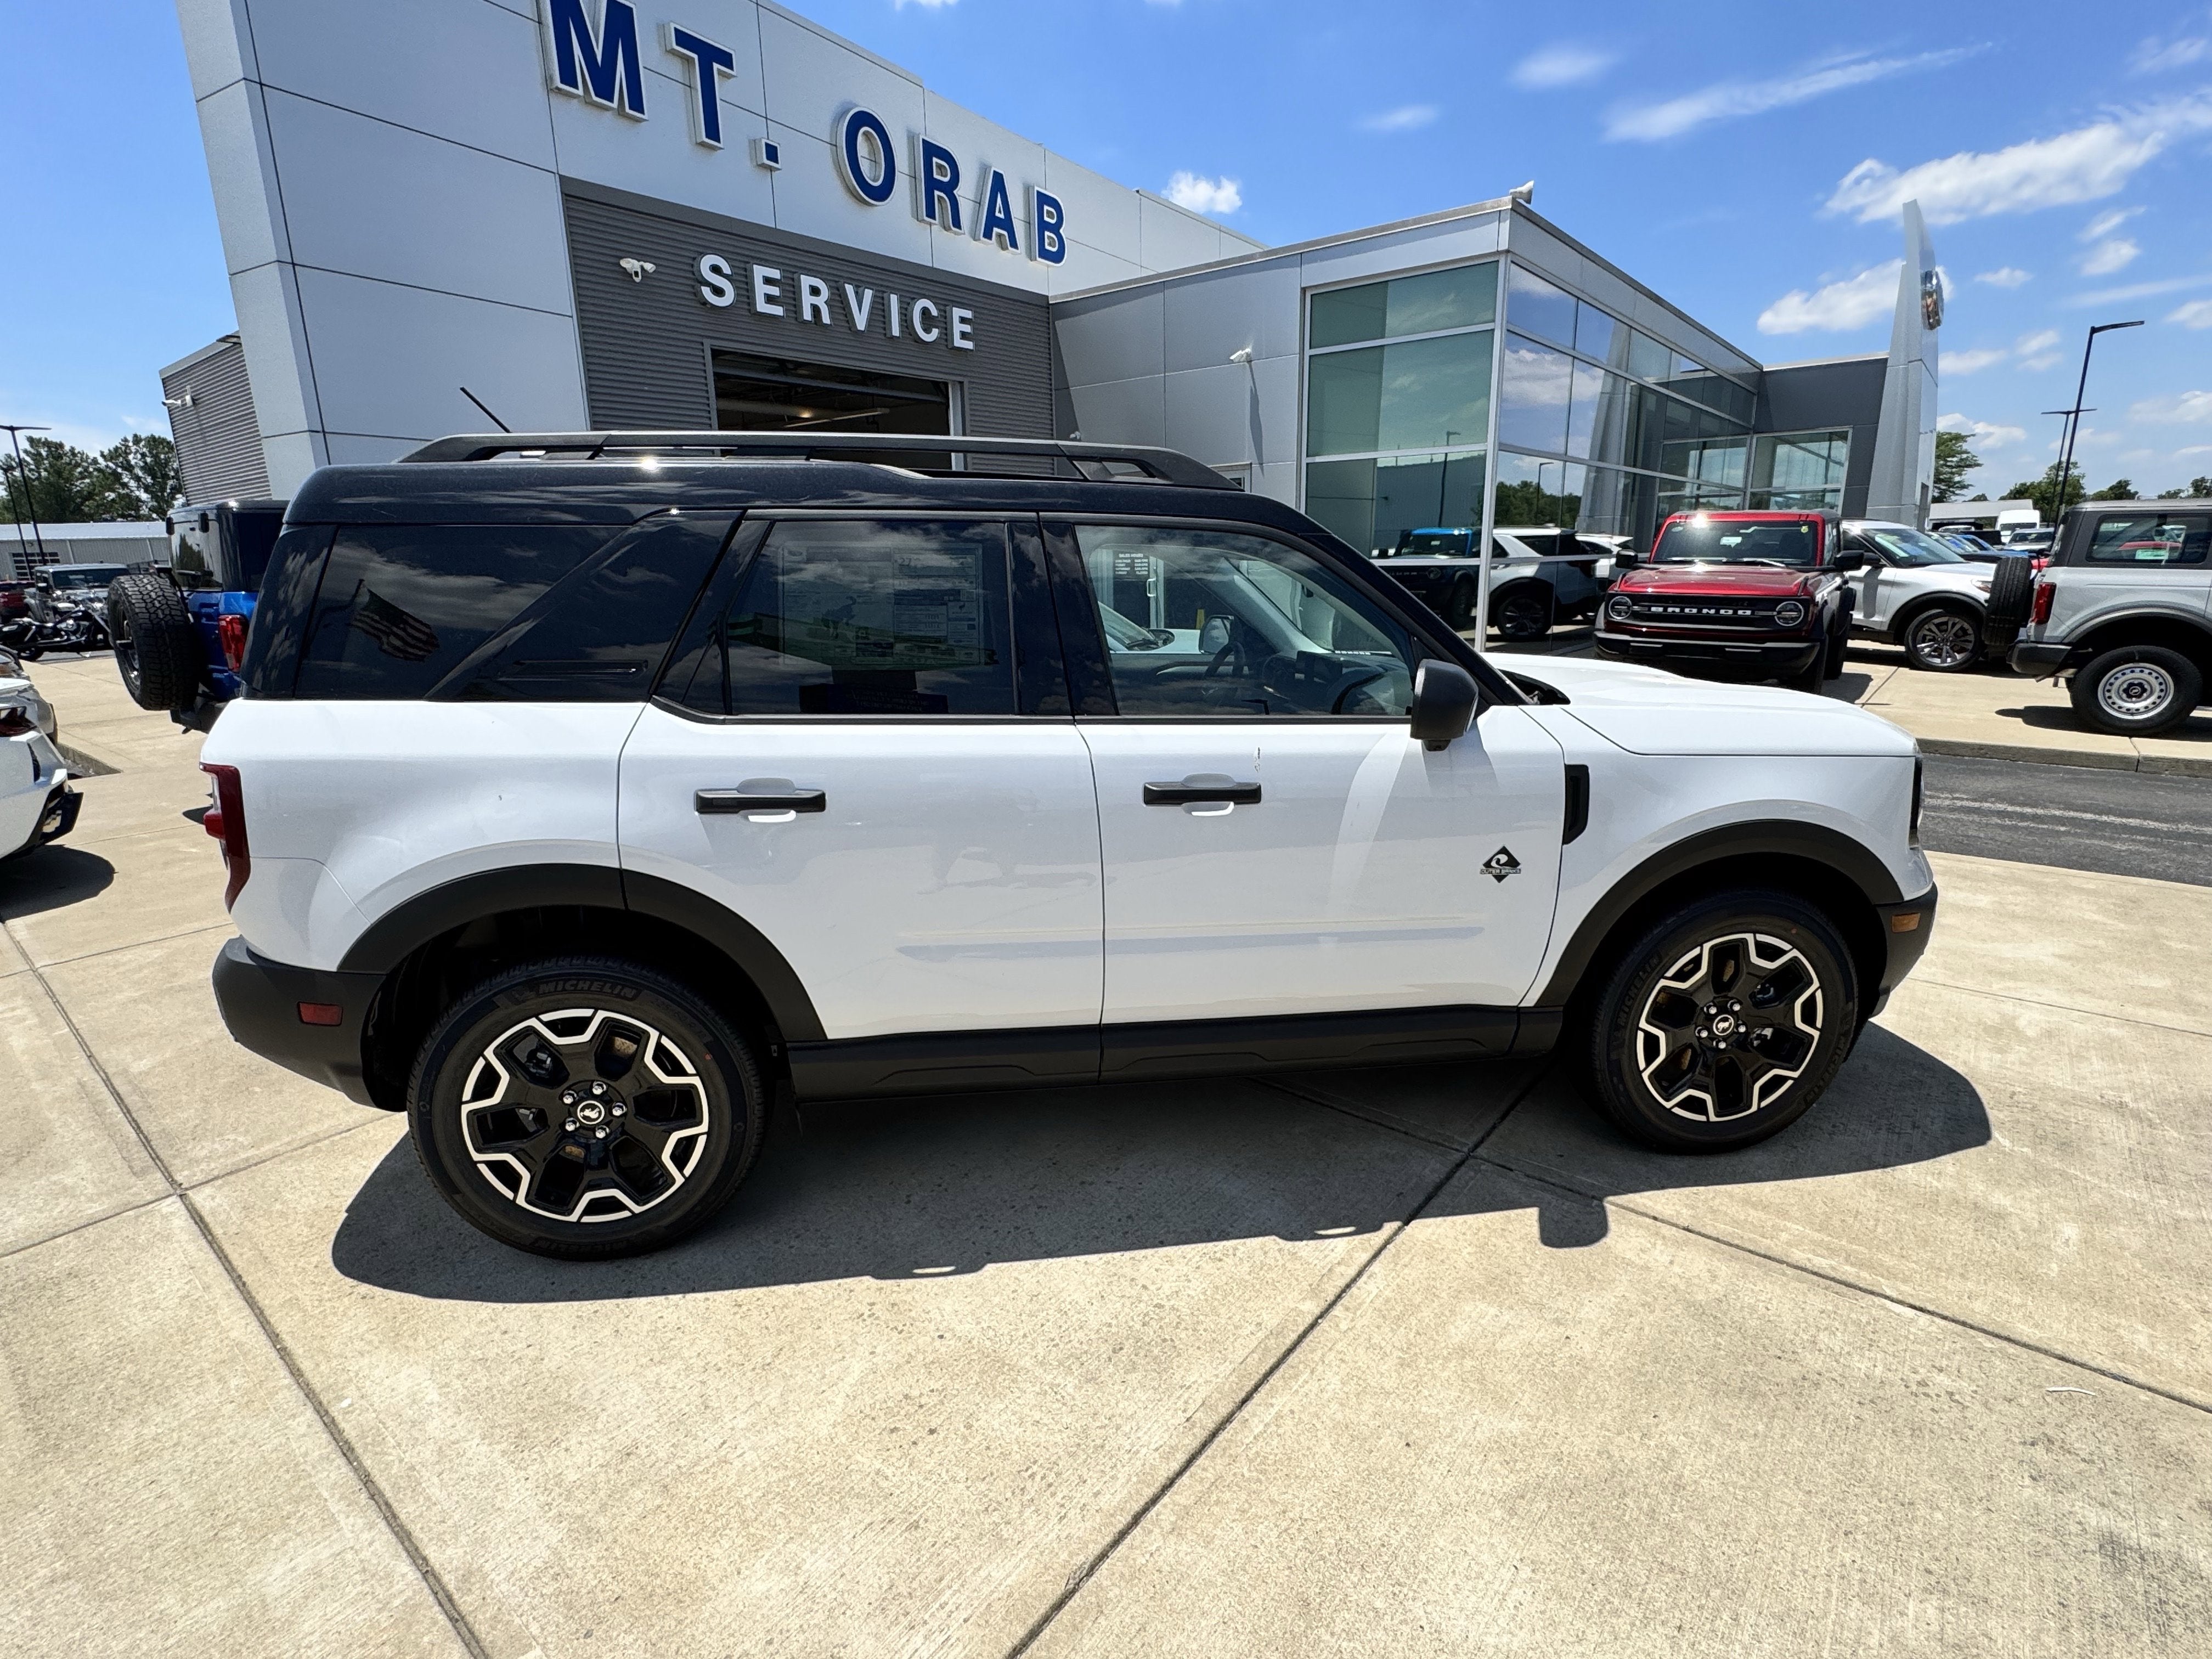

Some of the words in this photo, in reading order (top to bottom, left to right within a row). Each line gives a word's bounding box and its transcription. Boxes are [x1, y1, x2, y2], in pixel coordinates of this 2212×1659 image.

[549, 0, 781, 171] MT.
[838, 107, 1067, 267] ORAB
[699, 254, 974, 350] SERVICE
[1650, 606, 1752, 616] BRONCO
[538, 980, 637, 1000] MICHELIN
